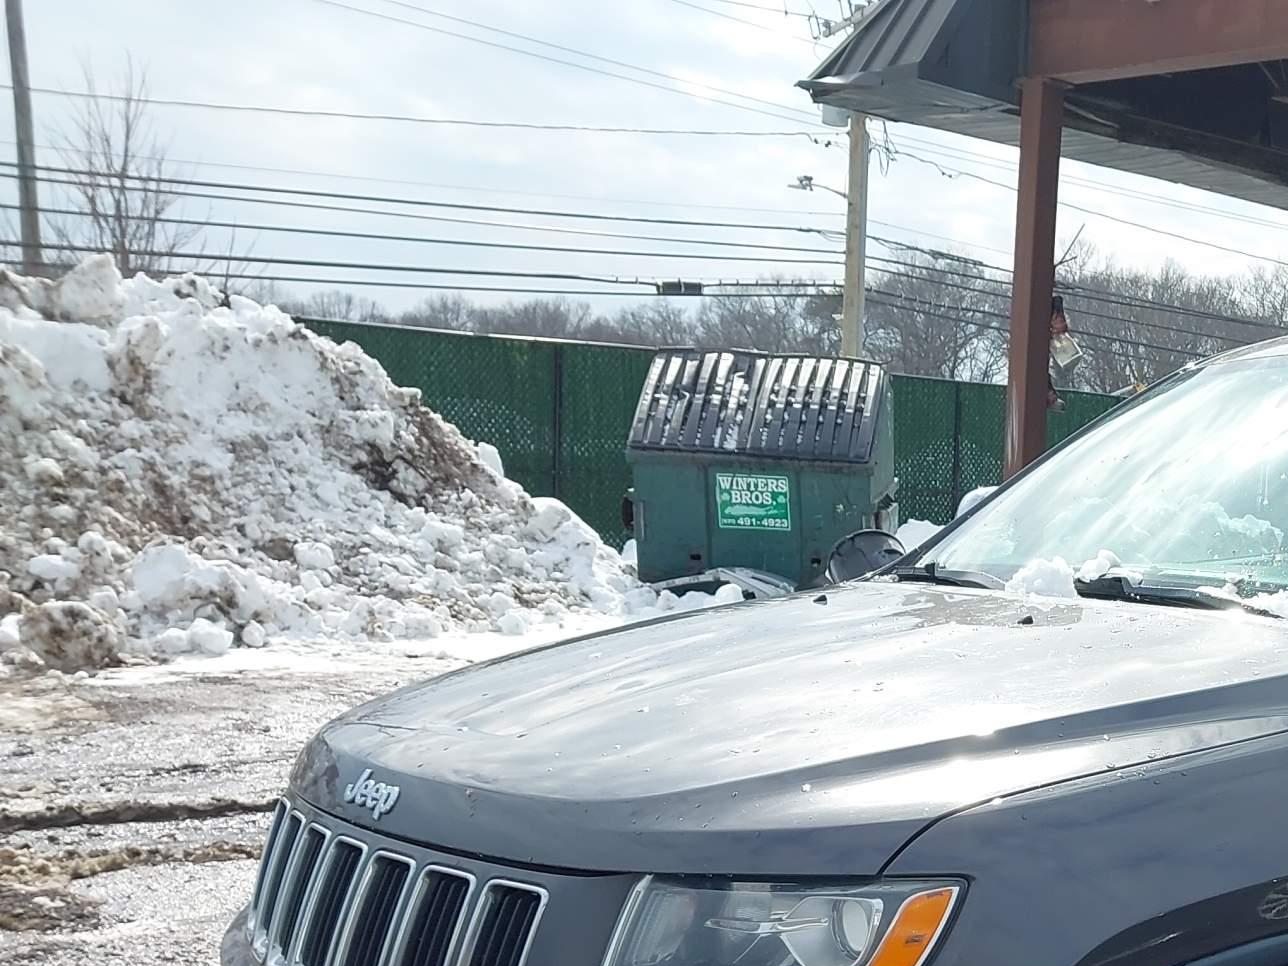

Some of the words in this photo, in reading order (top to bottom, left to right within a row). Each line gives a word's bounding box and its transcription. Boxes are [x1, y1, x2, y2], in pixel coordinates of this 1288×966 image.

[719, 477, 787, 492] WINTERS
[730, 490, 777, 505] BROS.
[738, 517, 788, 527] 491-4923
[343, 768, 400, 821] Jeep
